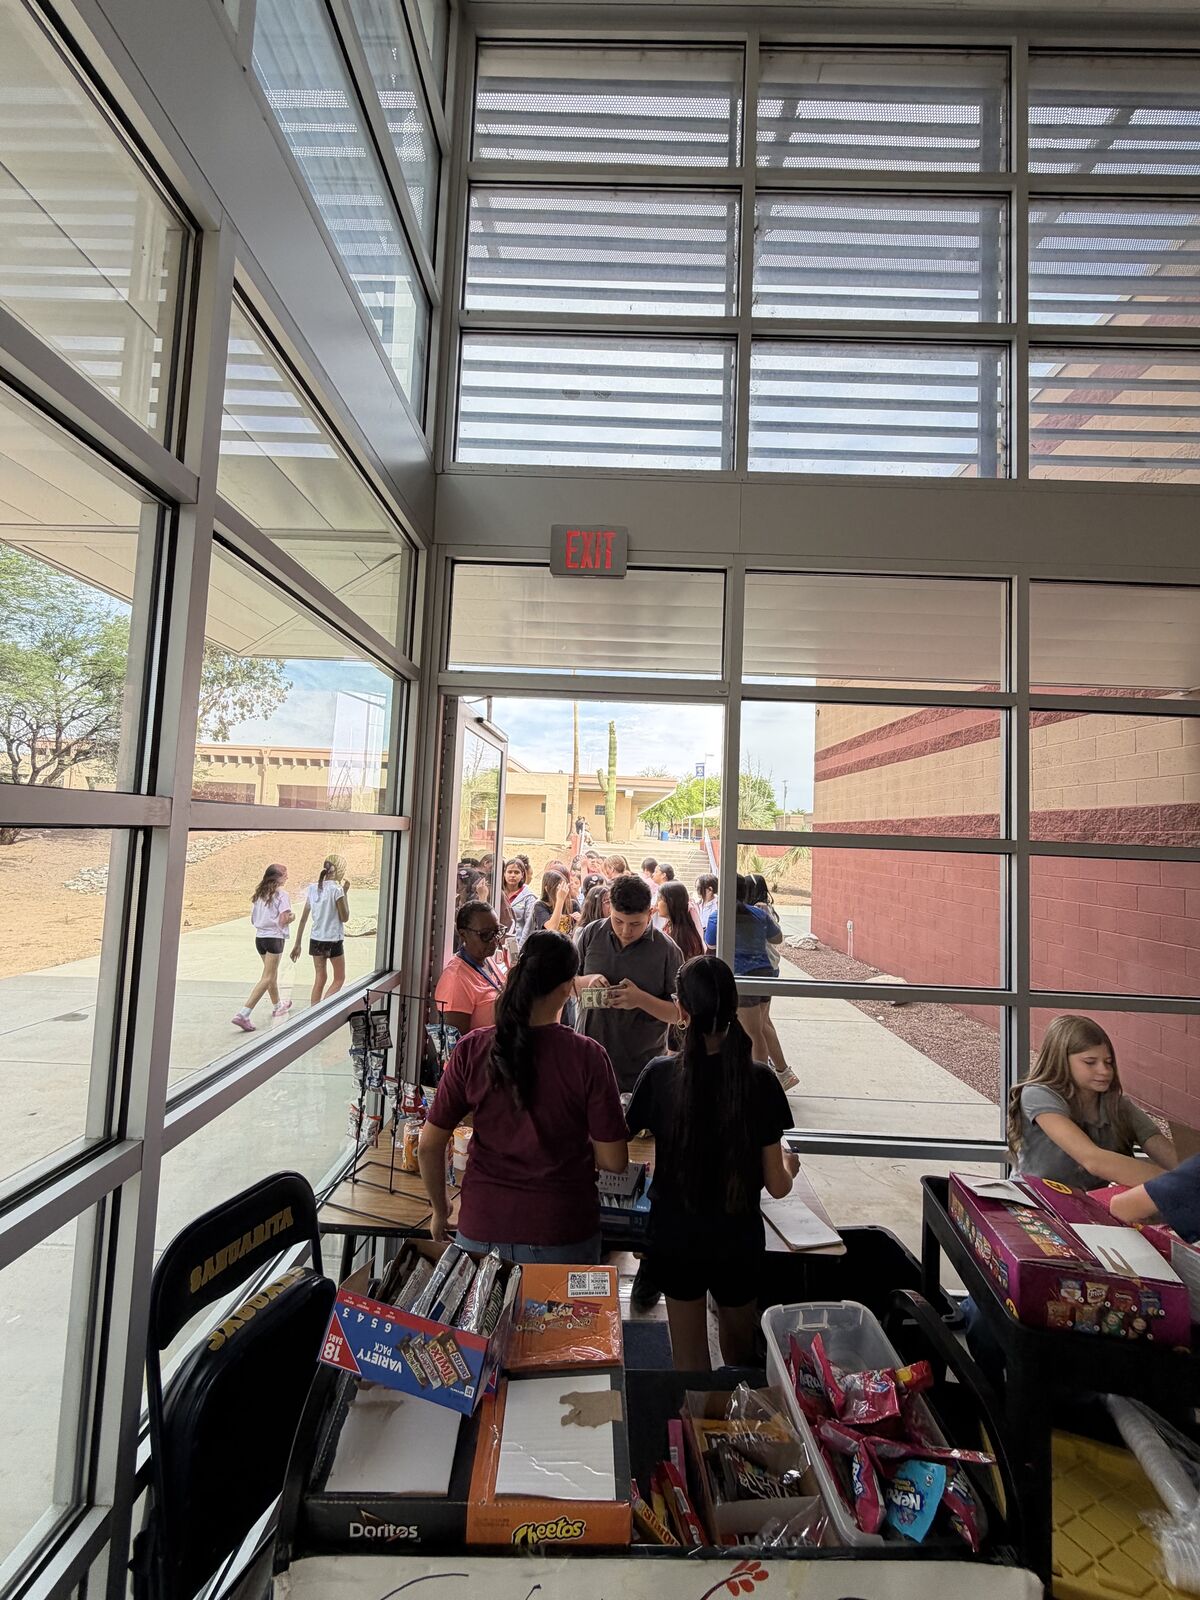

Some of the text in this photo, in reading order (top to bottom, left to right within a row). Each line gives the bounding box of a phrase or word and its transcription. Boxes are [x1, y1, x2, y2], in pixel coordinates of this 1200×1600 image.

[565, 530, 616, 569] EXIT
[190, 1206, 294, 1294] SAHUARITA
[342, 1307, 350, 1318] 3
[356, 1312, 365, 1323] 4
[370, 1317, 379, 1328] 5
[384, 1322, 393, 1333] 6
[328, 1333, 344, 1345] BARS
[323, 1343, 341, 1362] 18
[373, 1342, 392, 1356] PACK
[356, 1348, 402, 1374] VARIETY
[452, 1352, 470, 1379] SNICKERS
[350, 1522, 418, 1538] Doritos
